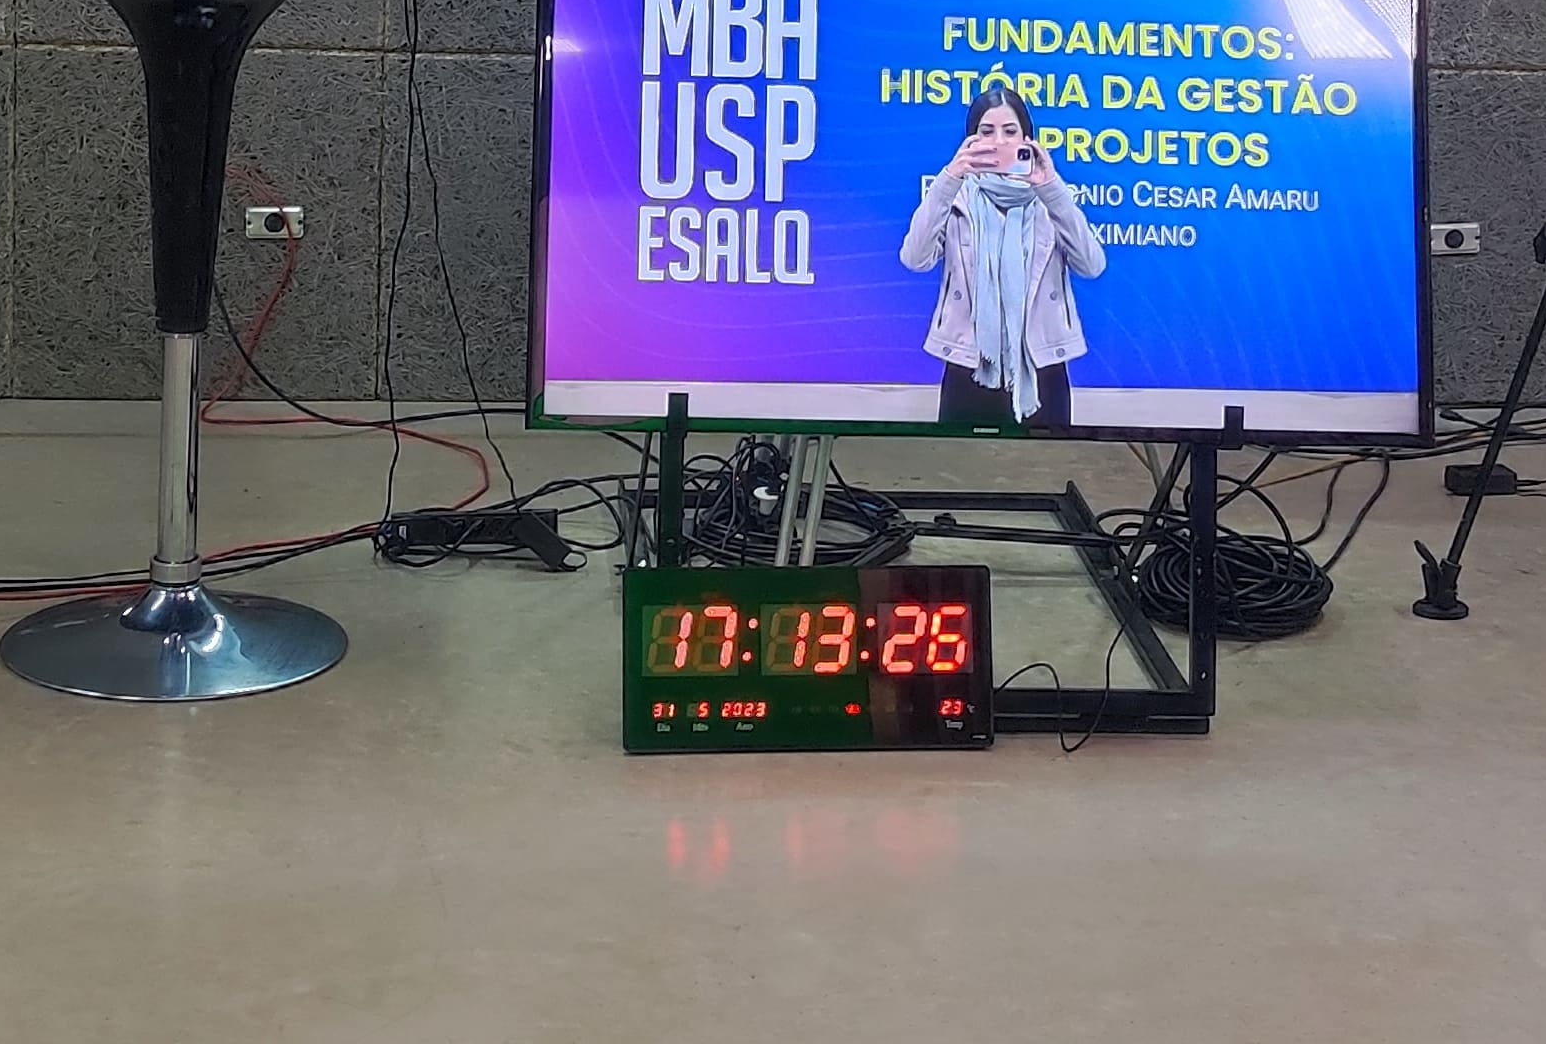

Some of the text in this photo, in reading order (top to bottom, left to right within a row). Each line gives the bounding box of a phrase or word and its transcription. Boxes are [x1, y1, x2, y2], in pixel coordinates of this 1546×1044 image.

[942, 16, 1296, 62] FUNDAMENTOS:
[880, 61, 1359, 116] HISTÓRIA DA GESTÃO
[640, 80, 817, 203] USP
[1038, 127, 1271, 169] PROJETOS
[1132, 181, 1218, 210] CESAR
[1224, 184, 1320, 212] AMARU
[638, 206, 815, 285] ESALQ
[1090, 223, 1197, 248] XIMIANO
[673, 605, 968, 674] 17:13:26
[652, 701, 675, 719] 31
[697, 701, 710, 719] 5
[721, 701, 769, 719] 2023
[939, 697, 965, 716] 23
